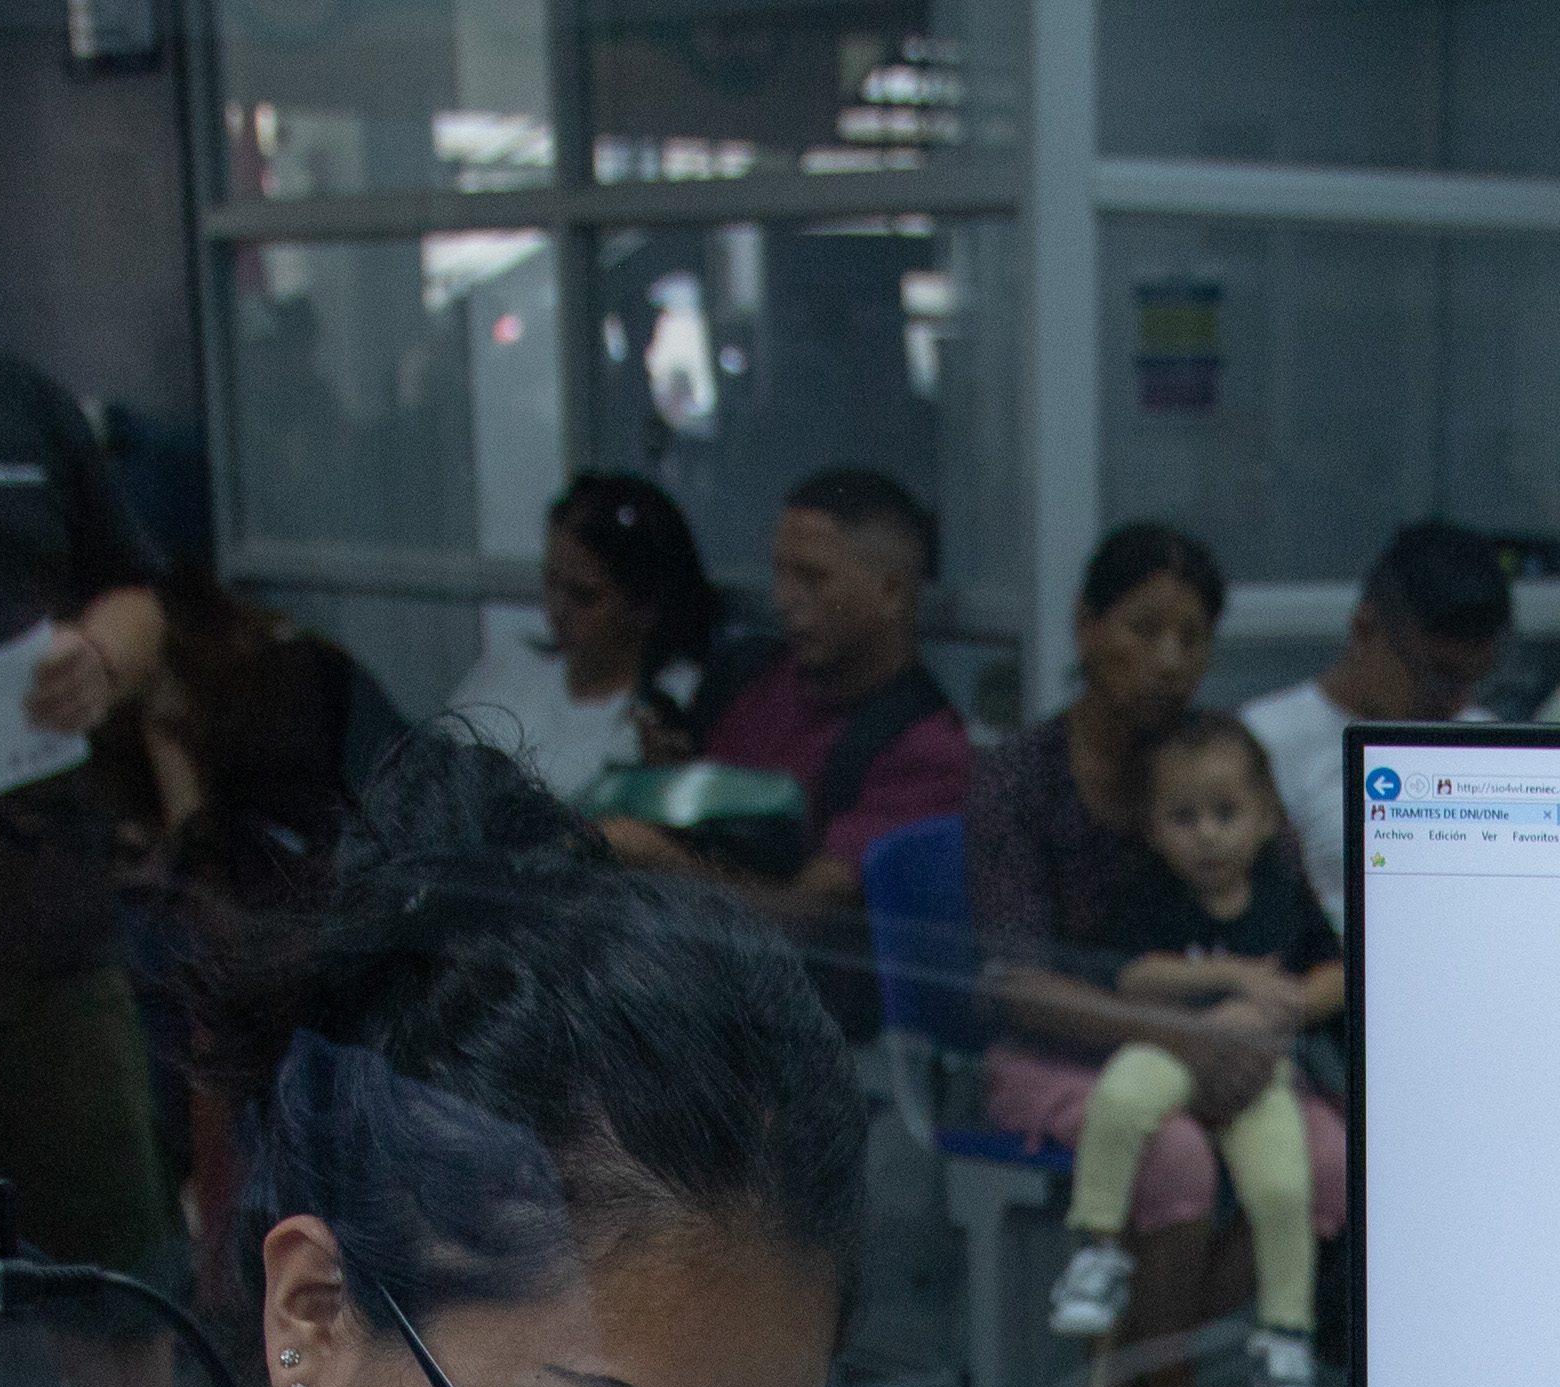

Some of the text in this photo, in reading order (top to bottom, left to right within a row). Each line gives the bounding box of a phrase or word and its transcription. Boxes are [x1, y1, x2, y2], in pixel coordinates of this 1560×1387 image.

[1390, 808, 1440, 820] TRAMITES
[1443, 809, 1457, 820] DE
[1373, 829, 1414, 841] Archivo
[1429, 829, 1467, 842] Edición
[1481, 831, 1498, 842] Ver
[1513, 831, 1559, 843] Favoritos
